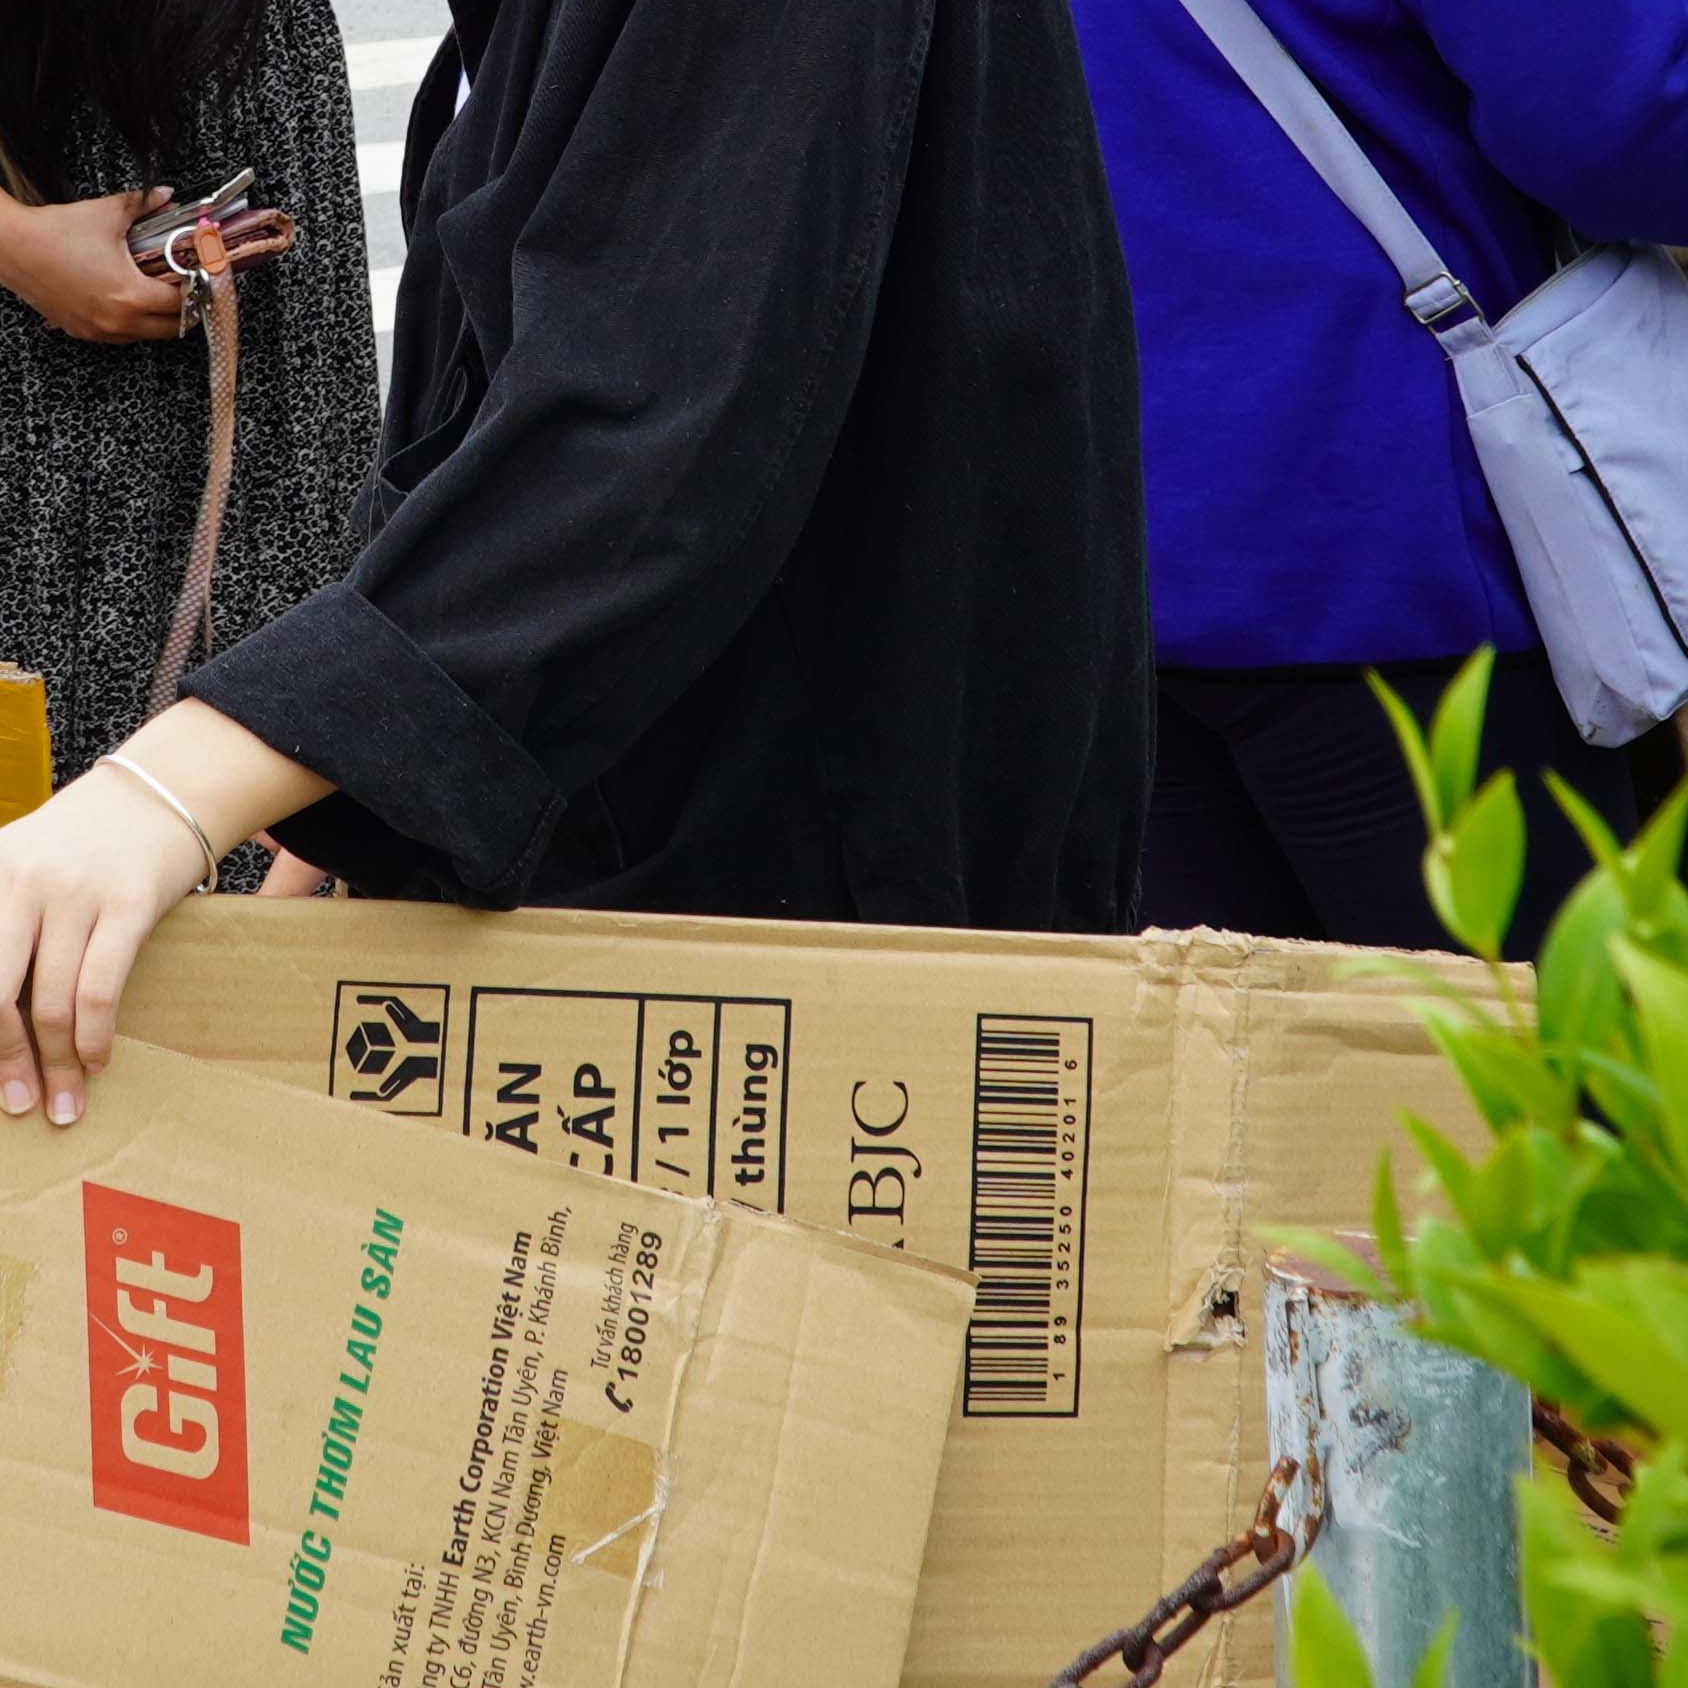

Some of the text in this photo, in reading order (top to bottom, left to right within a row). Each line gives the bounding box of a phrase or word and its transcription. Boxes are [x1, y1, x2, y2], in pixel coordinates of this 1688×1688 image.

[657, 1030, 702, 1104] lớp
[658, 1127, 690, 1144] 1
[731, 1043, 779, 1187] thùng
[848, 1081, 922, 1226] BJC
[503, 1231, 532, 1288] Nam
[540, 1206, 573, 1258] Bình,
[491, 1291, 524, 1341] Việt
[528, 1262, 558, 1326] Khánh
[590, 1221, 639, 1369] Tư vấn khách hàng
[616, 1231, 663, 1381] 18001289
[116, 1250, 220, 1480] Gift
[524, 1331, 545, 1346] P.
[280, 1207, 405, 1656] NƯỚC THƠM LAU SÀN
[459, 1347, 510, 1493] Corporation
[502, 1412, 529, 1444] Tân
[491, 1450, 519, 1499] Nam
[442, 1501, 477, 1568] Earth
[481, 1502, 509, 1544] KCN
[481, 1368, 569, 1688] Tân Uyên, Bình Dương, Việt Nam
[472, 1550, 501, 1585] N3,
[378, 1562, 426, 1688] ản xuất tại:
[429, 1572, 460, 1629] TNHH
[458, 1587, 494, 1654] đường
[426, 1634, 450, 1656] ty
